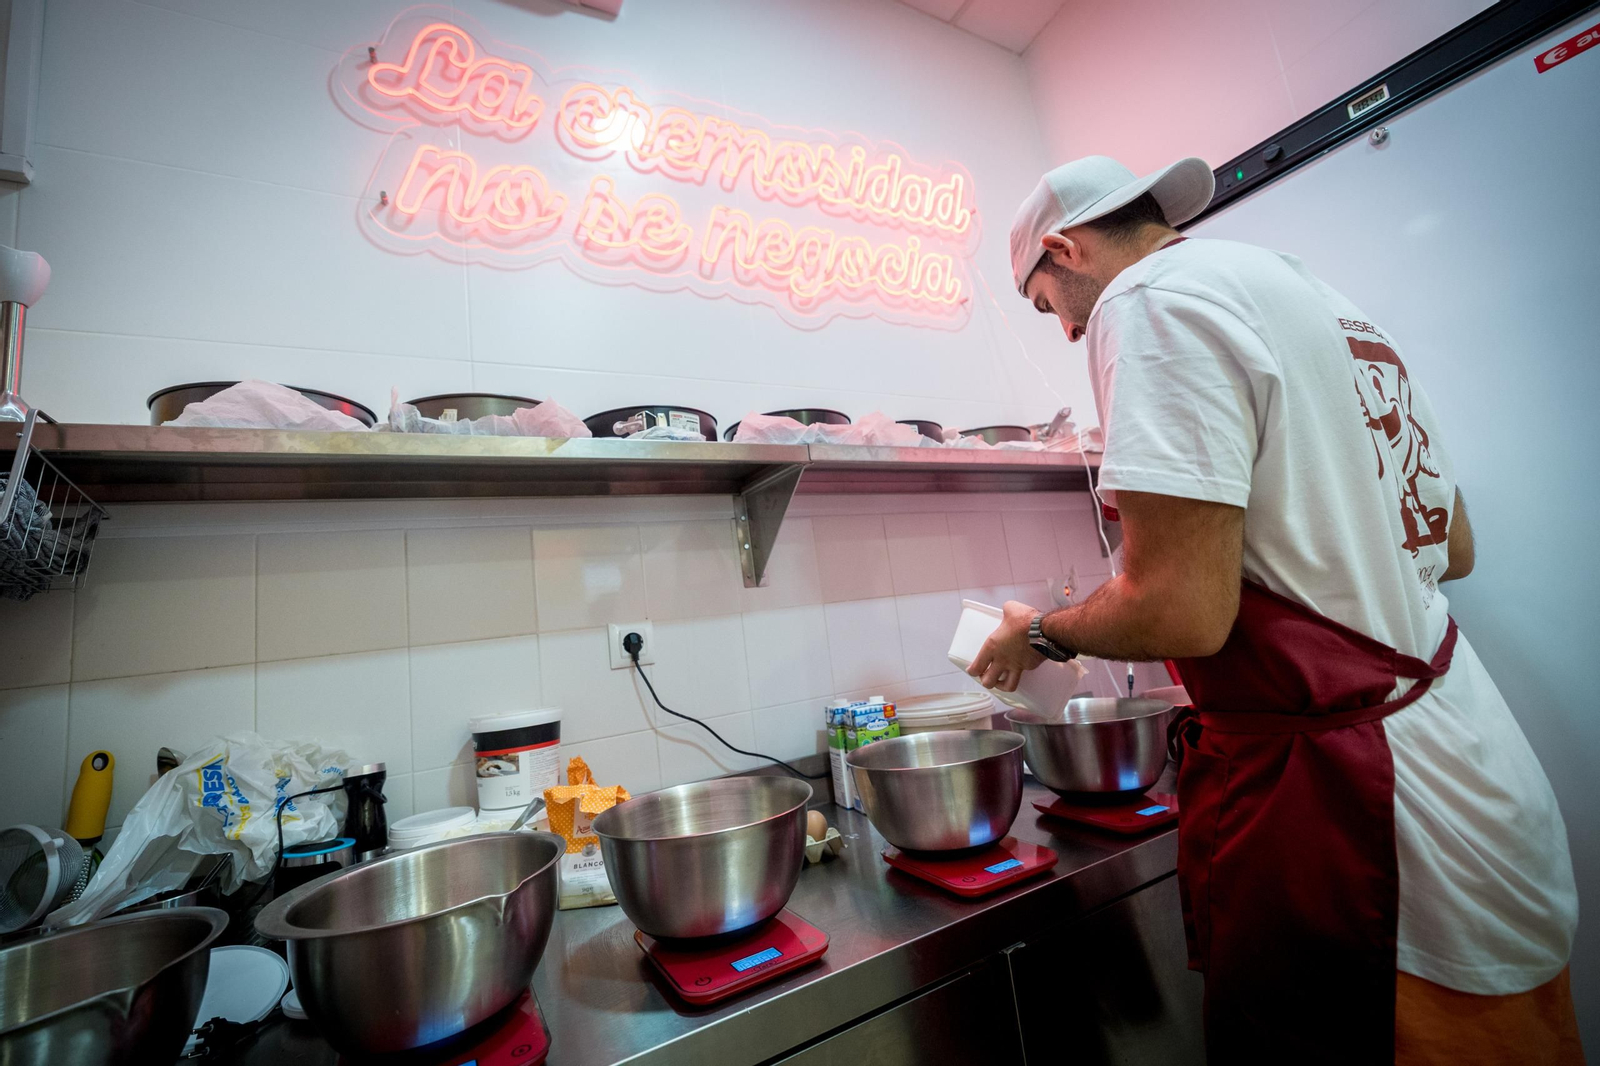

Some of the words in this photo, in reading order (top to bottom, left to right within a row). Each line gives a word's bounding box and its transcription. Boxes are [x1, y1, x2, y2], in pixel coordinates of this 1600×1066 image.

[368, 23, 545, 128] La
[395, 144, 570, 231] no
[701, 204, 963, 305] negocia
[573, 860, 604, 870] BLANCO
